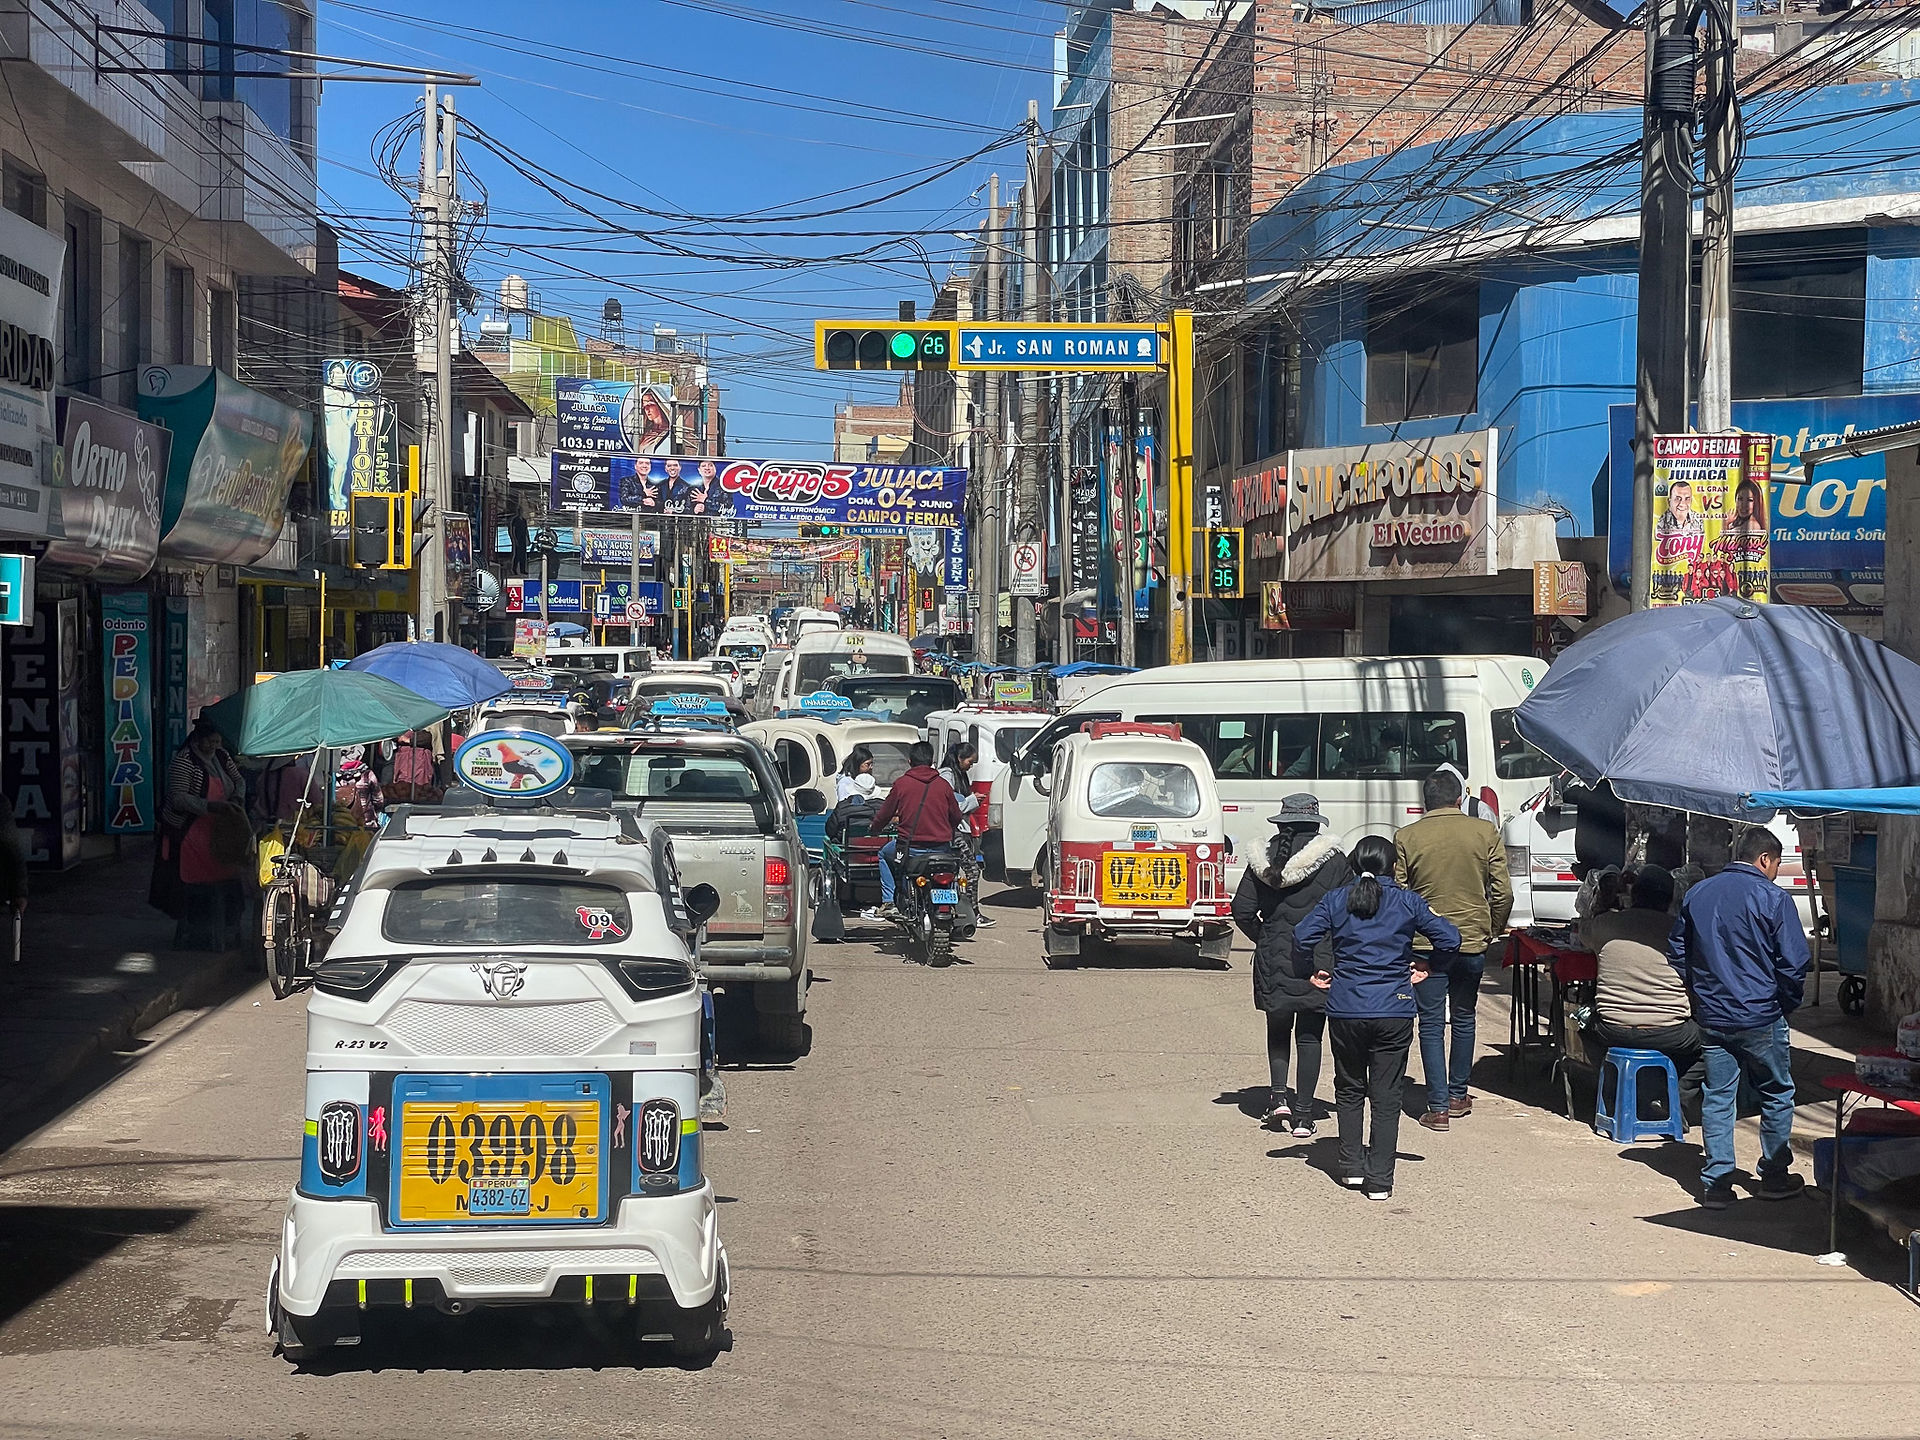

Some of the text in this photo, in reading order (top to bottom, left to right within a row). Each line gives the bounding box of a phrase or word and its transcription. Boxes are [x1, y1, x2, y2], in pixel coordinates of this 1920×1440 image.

[924, 337, 944, 355] 26
[988, 339, 1130, 356] Jr. SAN ROMAN
[593, 393, 620, 404] MARIA
[571, 402, 607, 413] JULIACA
[350, 400, 376, 493] BRION
[560, 437, 615, 451] 103.9 FM
[1656, 438, 1742, 455] CAMPO FERIAL
[1656, 459, 1741, 468] POR PRIMERA VEZ EN
[1748, 444, 1770, 466] 15
[560, 465, 609, 473] ENTRADAS
[1668, 469, 1728, 480] JULIACA
[822, 465, 856, 497] 5
[858, 467, 944, 491] JULIACA
[848, 488, 953, 509] DOM. 04 JUNIO
[1290, 449, 1482, 533] SALCHIPOLLOS
[745, 504, 836, 515] FESTIVAL GASTRONÓMICO
[1702, 495, 1723, 511] VS
[846, 508, 960, 527] CAMPO FERIAL
[1372, 519, 1465, 547] El Vecino
[1774, 528, 1791, 541] Tu
[1796, 527, 1850, 541] Sonrisa
[610, 541, 632, 550] AGUST
[711, 538, 727, 552] 14
[1656, 533, 1704, 561] Tony
[1709, 533, 1769, 557] Marisol
[1214, 569, 1233, 587] 36
[103, 618, 147, 631] Odonto
[111, 633, 144, 828] PEDIATRIA
[471, 766, 502, 776] AEROPUERTO
[588, 914, 611, 927] 09
[335, 1040, 366, 1050] R-23
[426, 1114, 577, 1186] 03998
[488, 1180, 512, 1188] PERU
[473, 1188, 526, 1206] 4382-6Z
